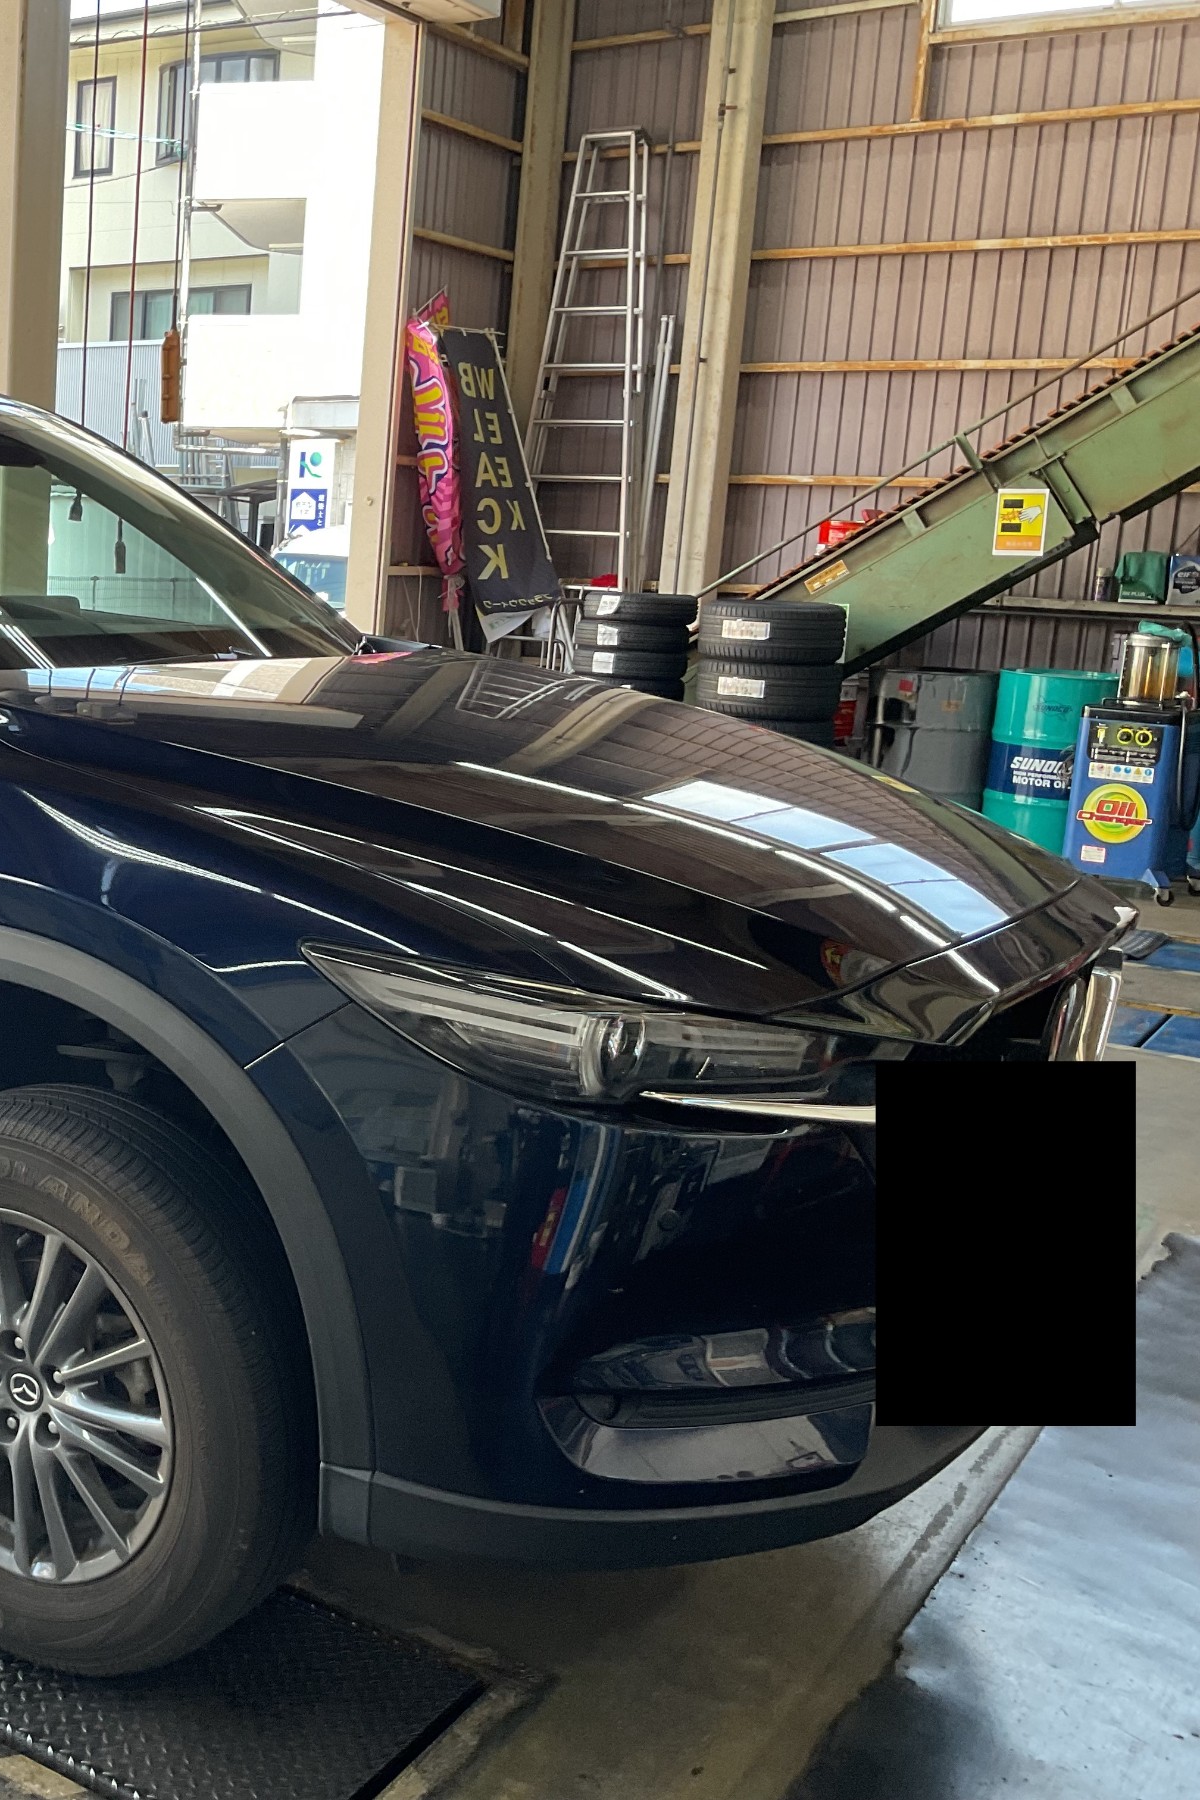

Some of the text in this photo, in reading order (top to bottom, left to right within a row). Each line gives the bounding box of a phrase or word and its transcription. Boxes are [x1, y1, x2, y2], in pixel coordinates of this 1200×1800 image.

[1010, 756, 1072, 774] SUNO
[1012, 775, 1072, 790] MOTOR OI
[1096, 799, 1137, 817] Oil
